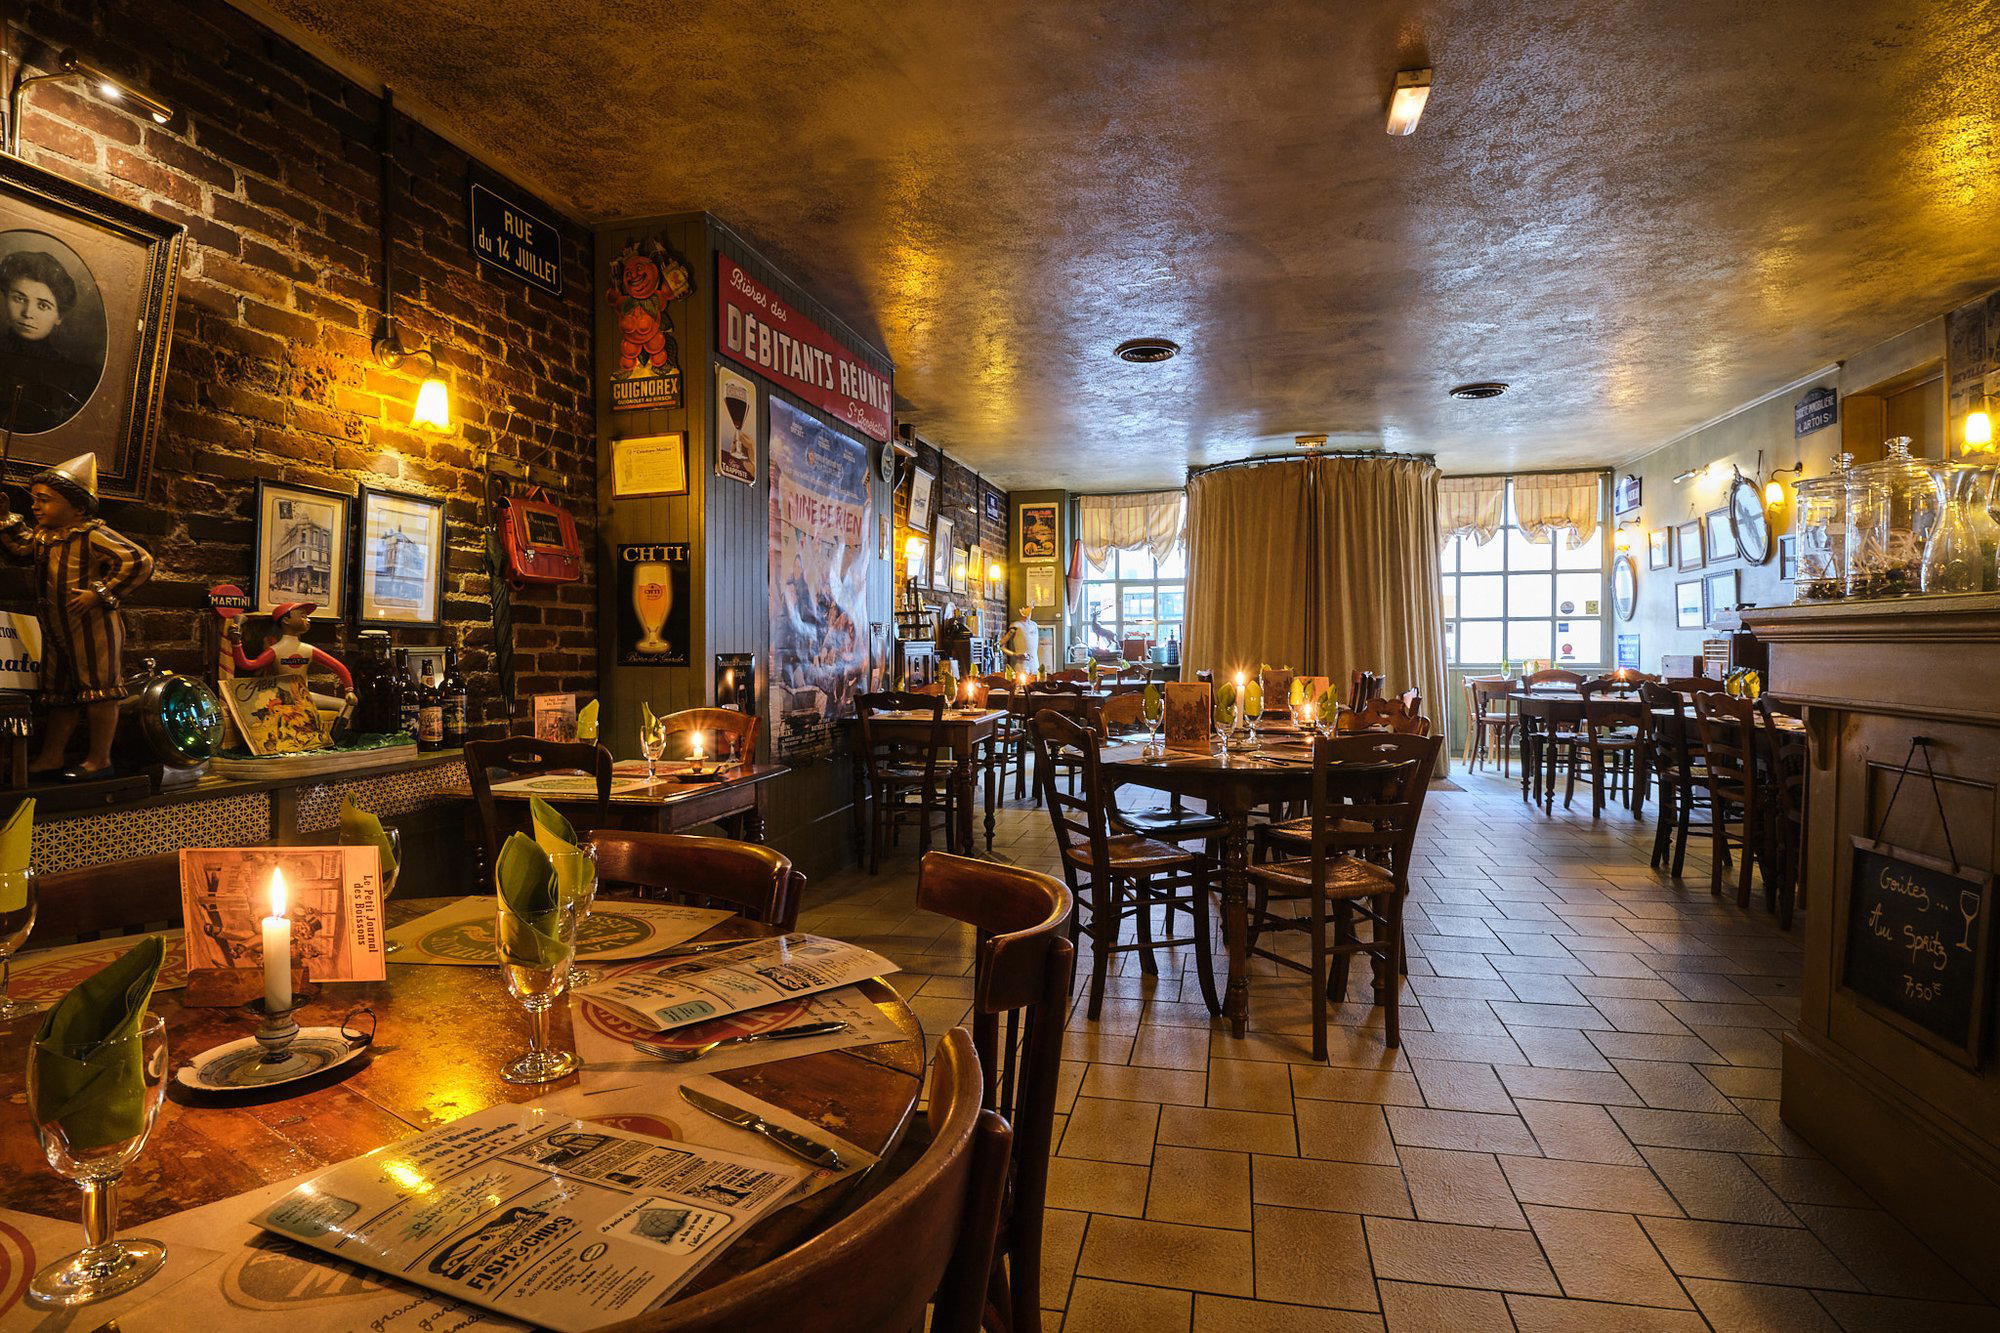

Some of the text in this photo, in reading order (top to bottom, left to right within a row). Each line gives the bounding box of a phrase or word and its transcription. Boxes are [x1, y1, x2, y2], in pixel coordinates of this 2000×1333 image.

[504, 210, 533, 245] RUE
[478, 226, 557, 285] du 14 JUILLET
[729, 267, 788, 322] Bières des
[726, 302, 890, 414] DÉBITANTS RÉUNIS
[613, 378, 679, 400] GUIGNOREX
[622, 545, 684, 562] CH'TI
[210, 594, 250, 607] MARTINI
[354, 883, 366, 946] des Boissons
[364, 875, 379, 953] Le Petit Journal
[1903, 925, 1948, 971] Spritz
[466, 1216, 573, 1290] FISH&CHIPS
